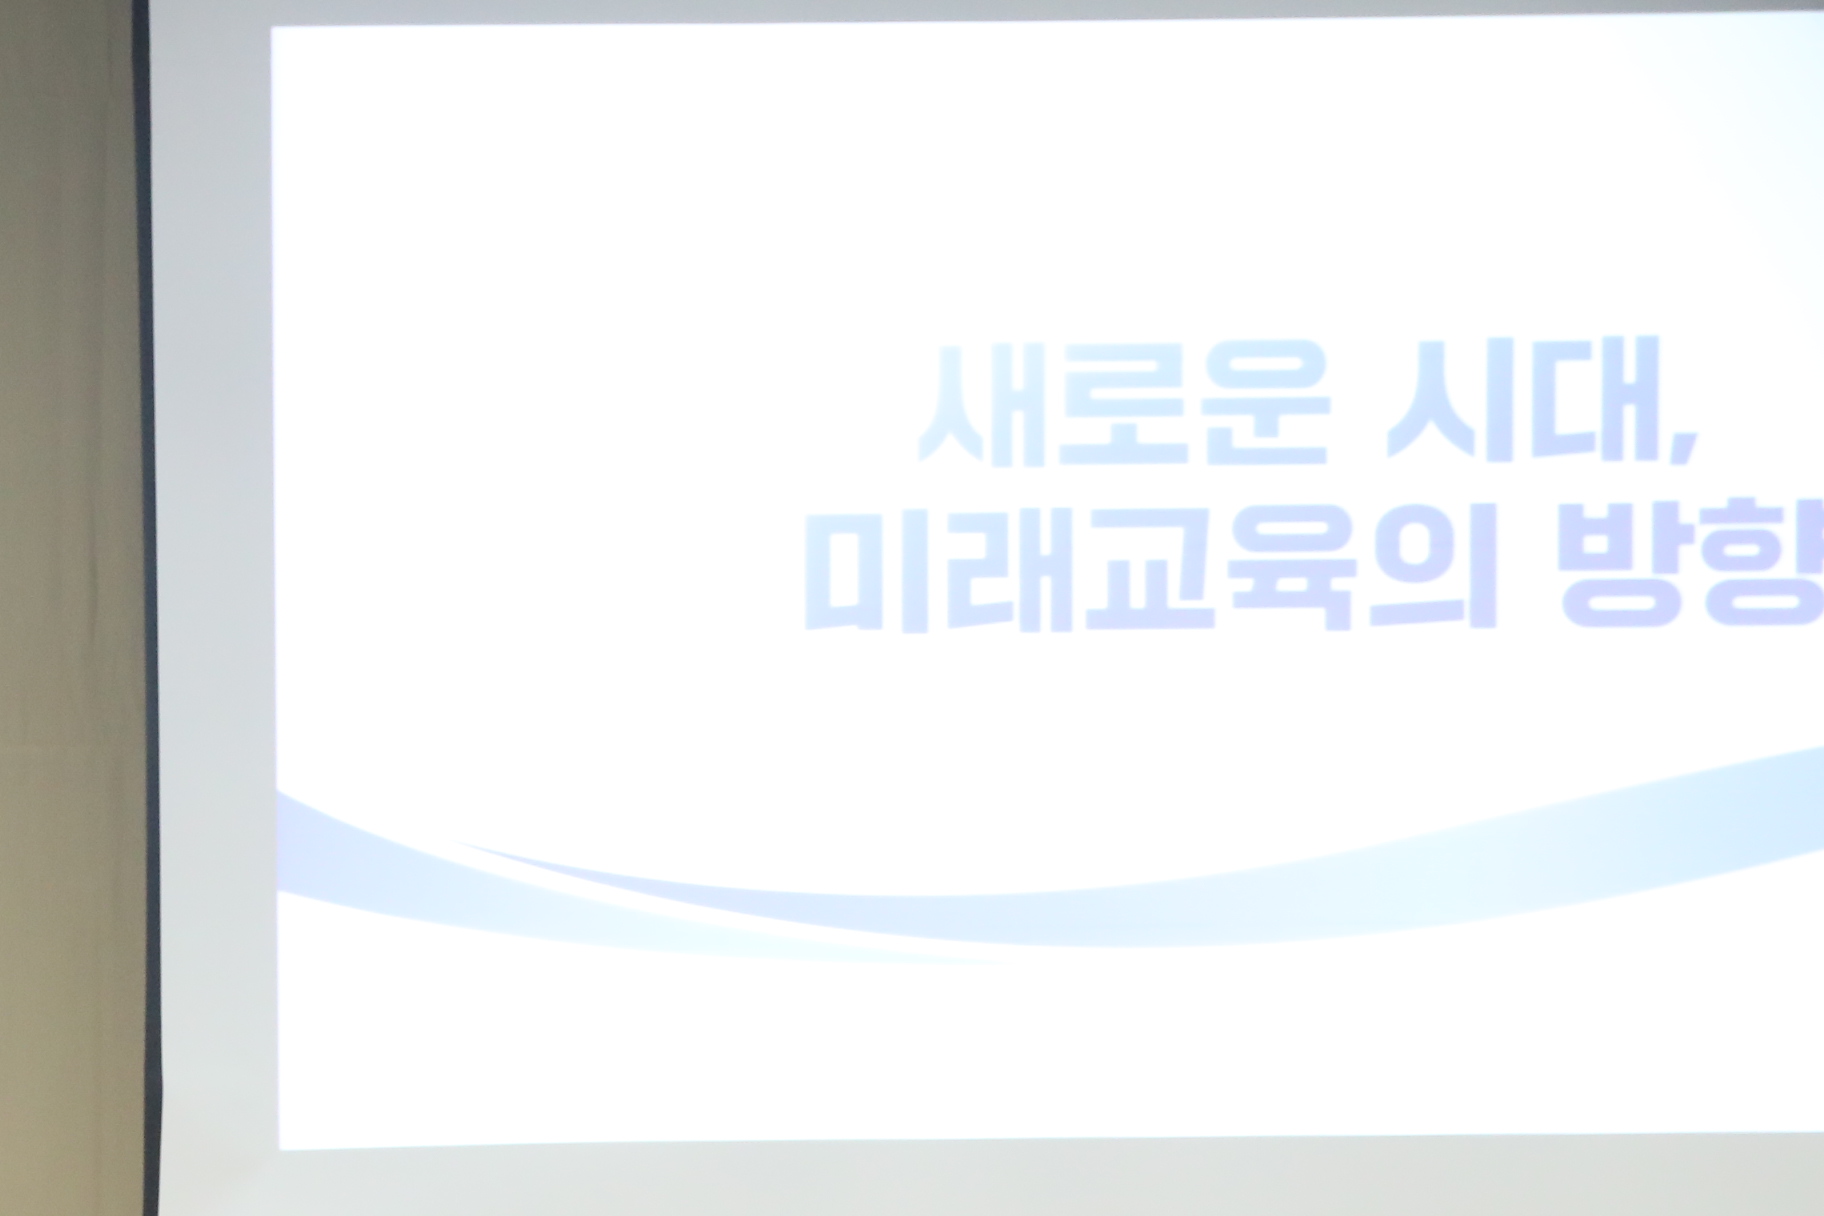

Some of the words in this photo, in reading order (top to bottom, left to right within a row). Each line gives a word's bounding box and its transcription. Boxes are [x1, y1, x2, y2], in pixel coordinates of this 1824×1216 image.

[919, 339, 1332, 468] 새로운
[1387, 335, 1699, 467] 시대,
[805, 503, 1499, 634] 미래교육의
